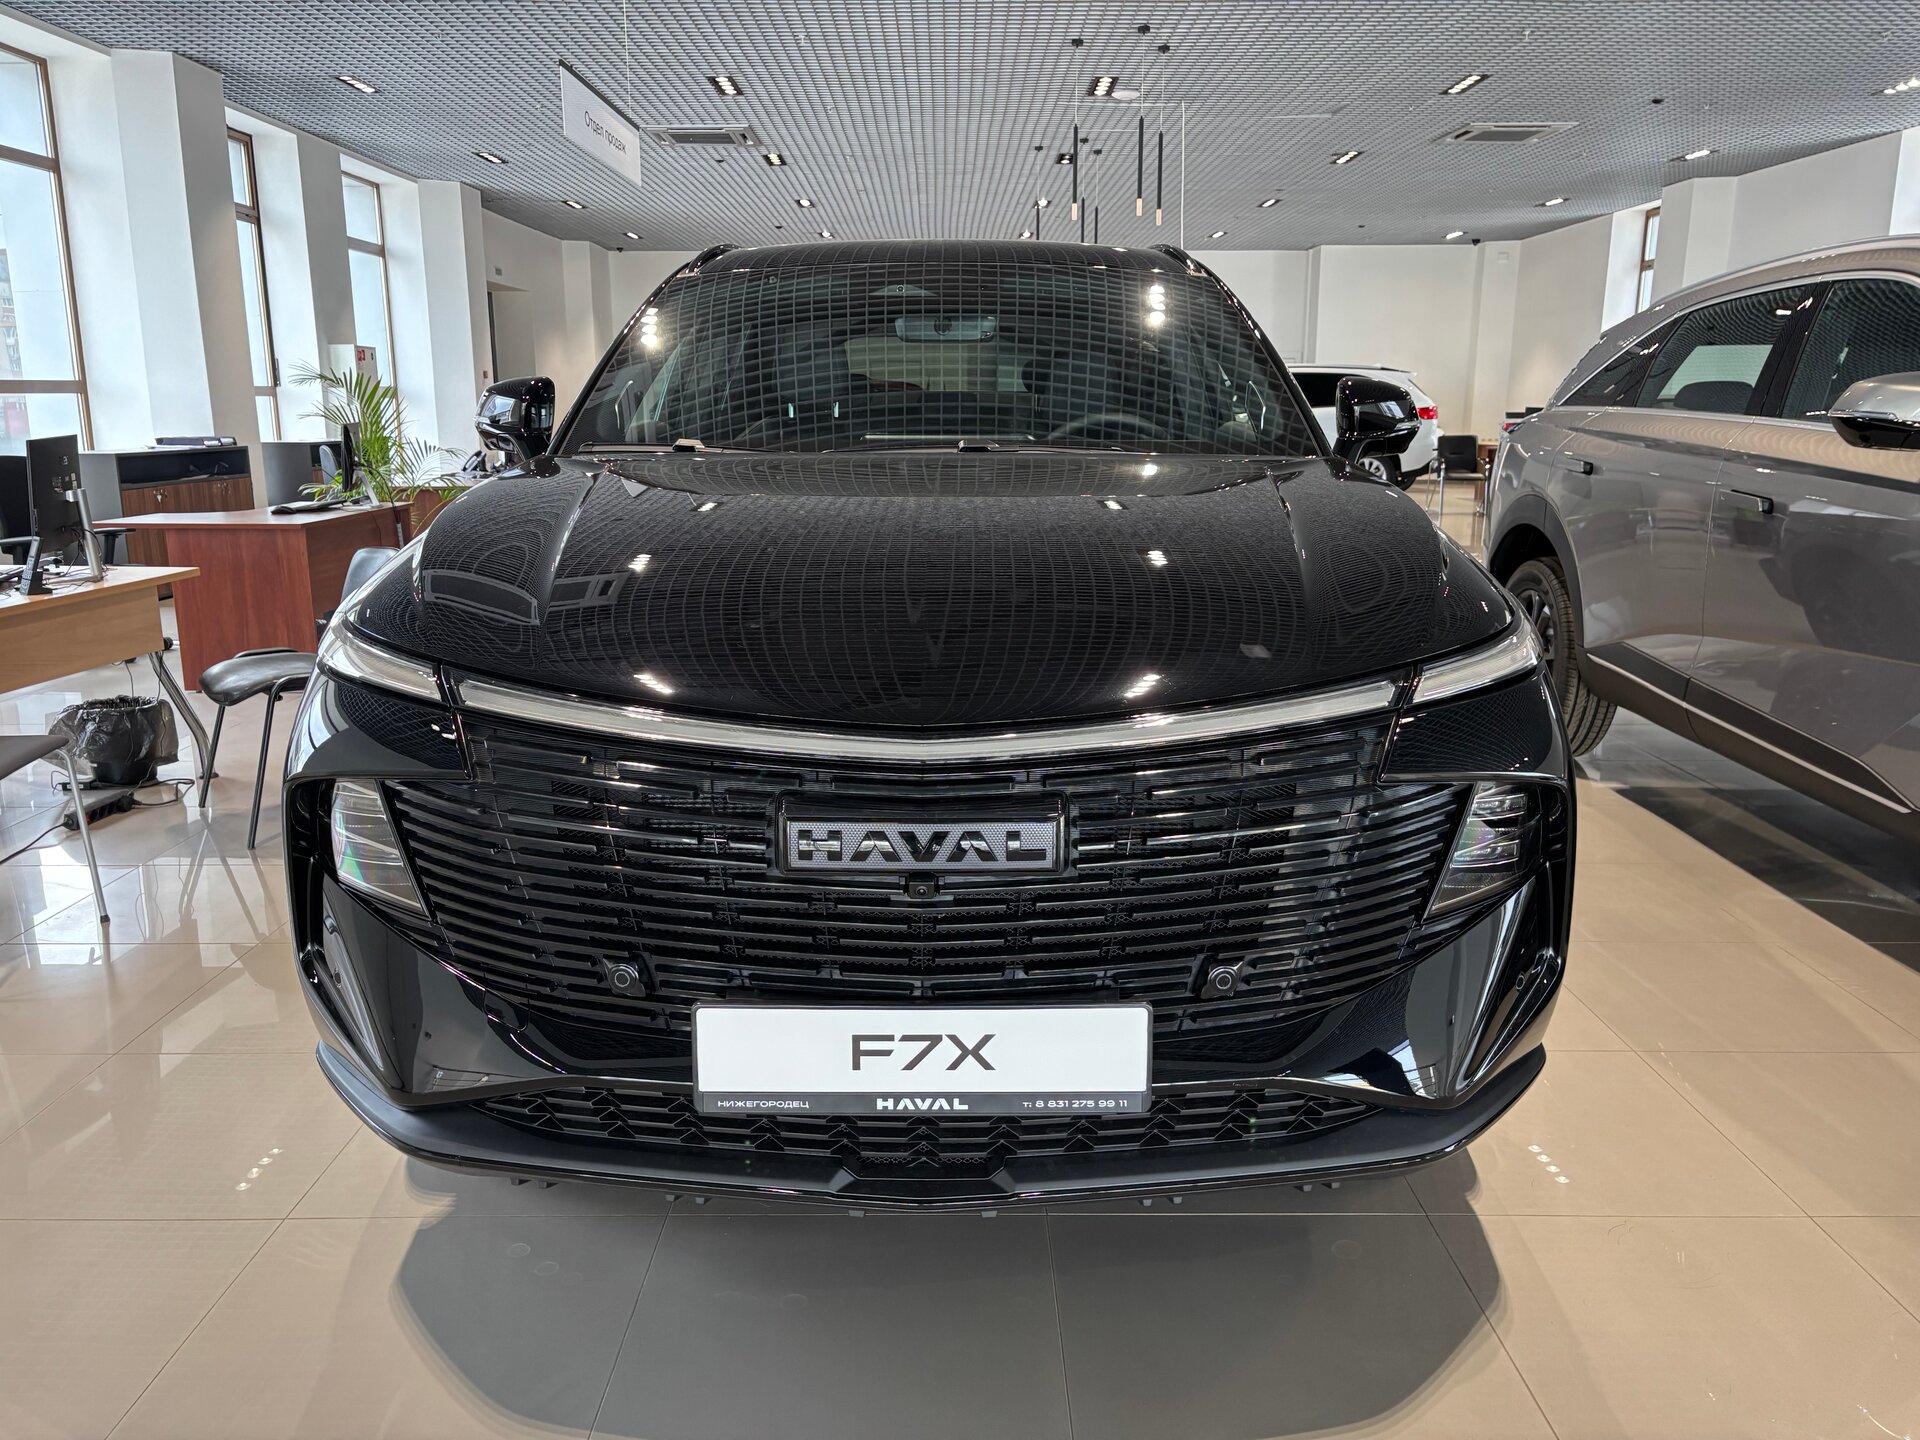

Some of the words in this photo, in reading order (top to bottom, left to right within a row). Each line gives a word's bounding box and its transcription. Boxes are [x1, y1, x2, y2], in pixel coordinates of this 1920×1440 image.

[584, 110, 605, 139] Отдел
[604, 129, 627, 155] продаж
[797, 829, 1047, 863] HAVAL
[851, 1033, 997, 1071] F7X
[717, 1099, 810, 1110] НИЖЕГОРОДЕЦ
[876, 1097, 969, 1110] HAVAL
[1035, 1100, 1045, 1108] 8
[1047, 1100, 1069, 1108] 831
[1071, 1100, 1095, 1108] 275
[1098, 1100, 1116, 1108] 99
[1118, 1100, 1128, 1108] 11
